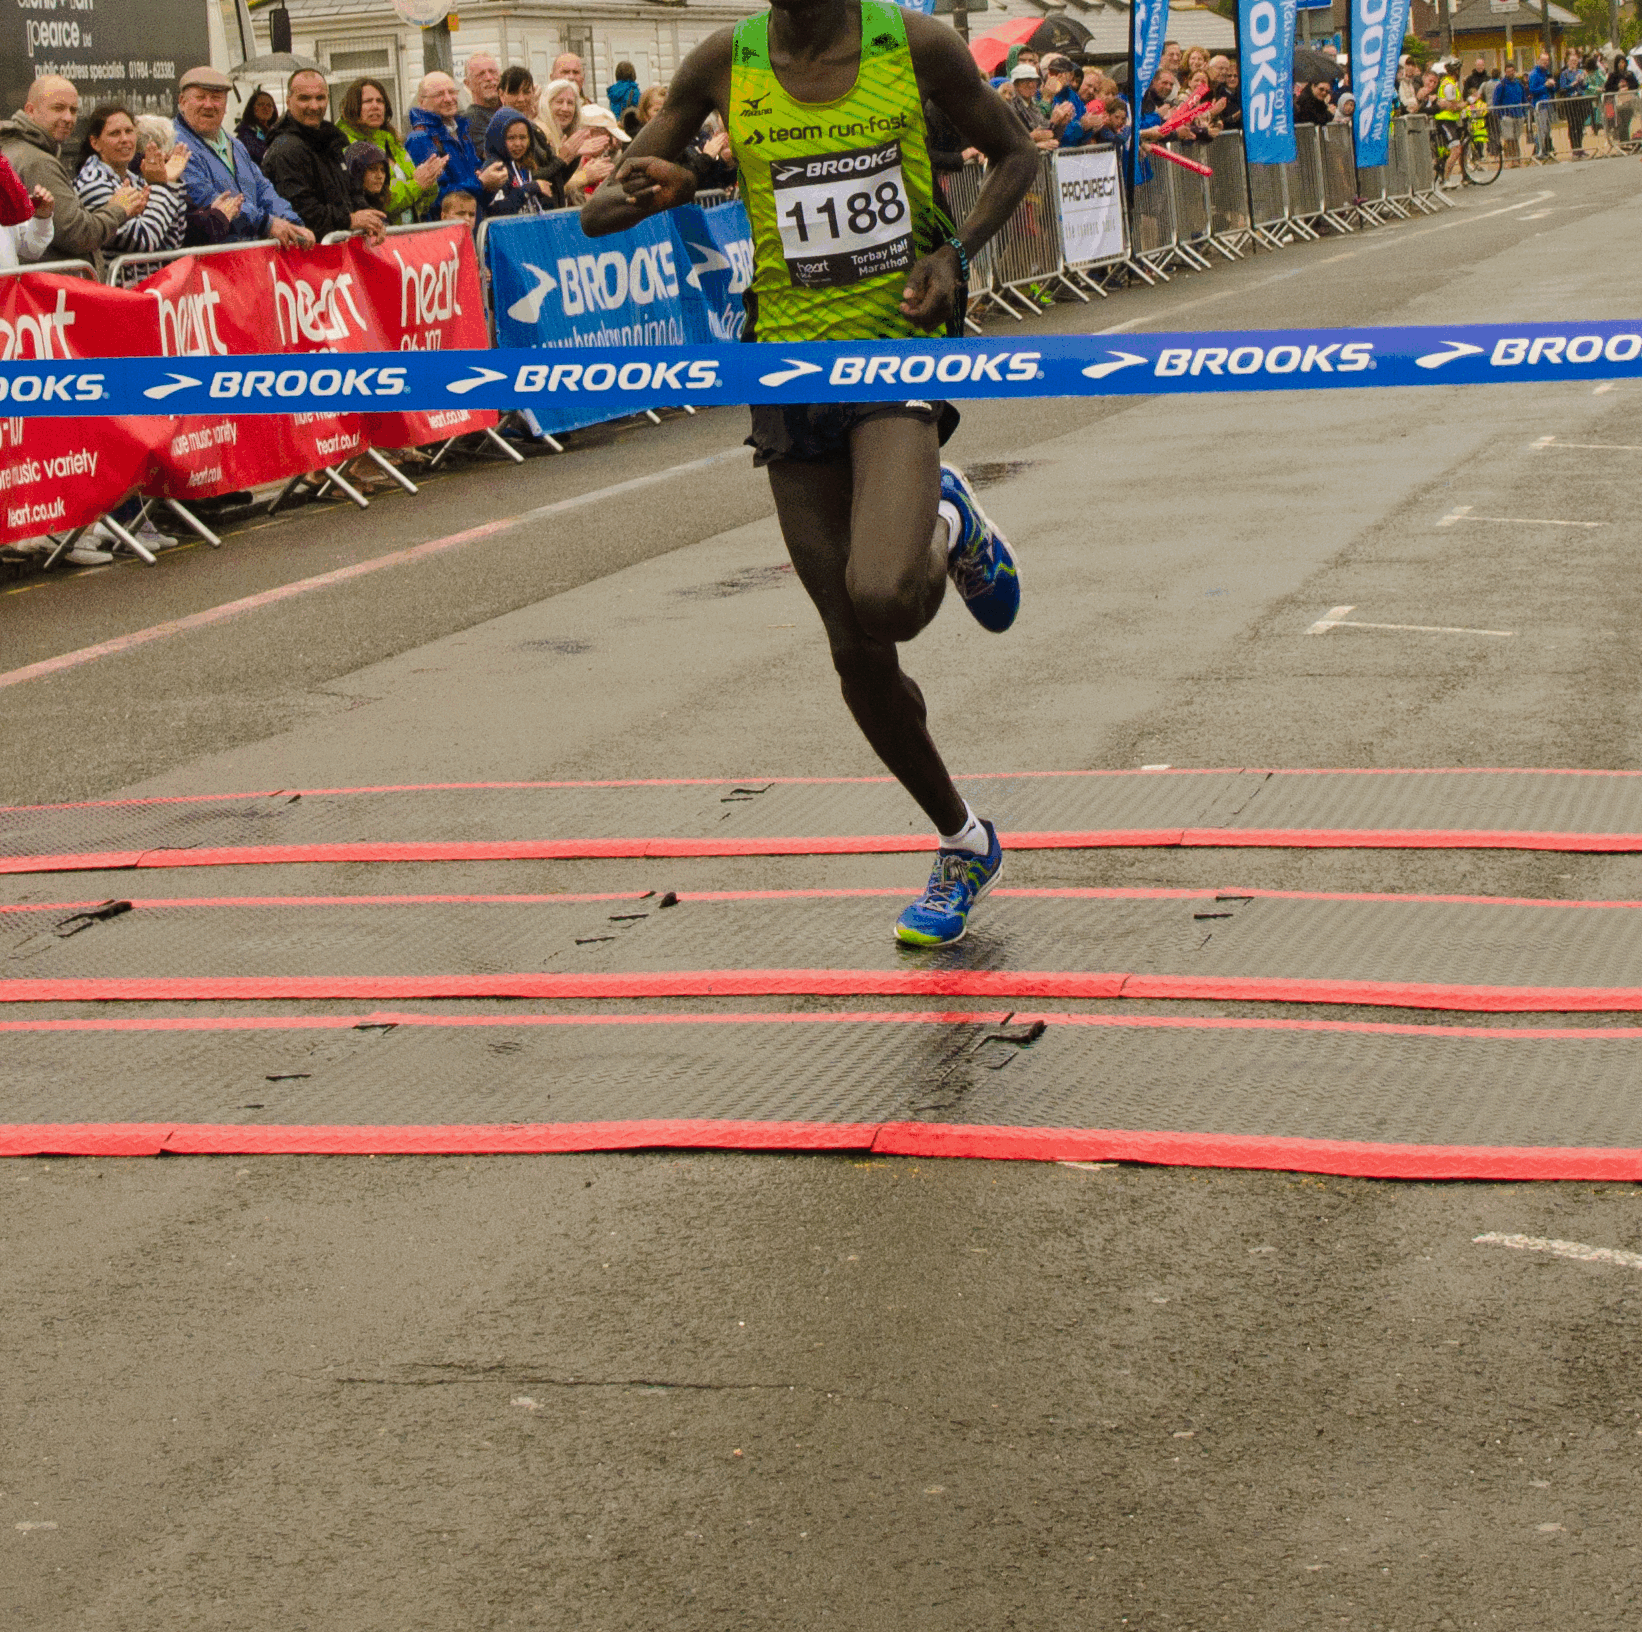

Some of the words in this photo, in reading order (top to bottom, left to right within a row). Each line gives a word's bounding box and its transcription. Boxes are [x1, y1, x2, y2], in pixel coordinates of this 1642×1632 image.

[769, 125, 823, 143] team
[829, 112, 908, 139] run-fast
[807, 144, 898, 177] BROOKS
[785, 180, 906, 243] 1188
[797, 259, 830, 273] heart
[850, 249, 888, 265] Torbay
[889, 238, 908, 256] Half
[858, 255, 909, 276] Marathon
[393, 241, 462, 327] heart
[557, 241, 680, 316] BROOKS
[145, 271, 227, 356] heart
[269, 261, 367, 346] heart
[209, 367, 407, 398] BROOKS
[514, 360, 720, 392] BROOKS
[829, 352, 1042, 385] BROOKS
[1154, 342, 1372, 377] BROOKS
[44, 447, 98, 478] variety
